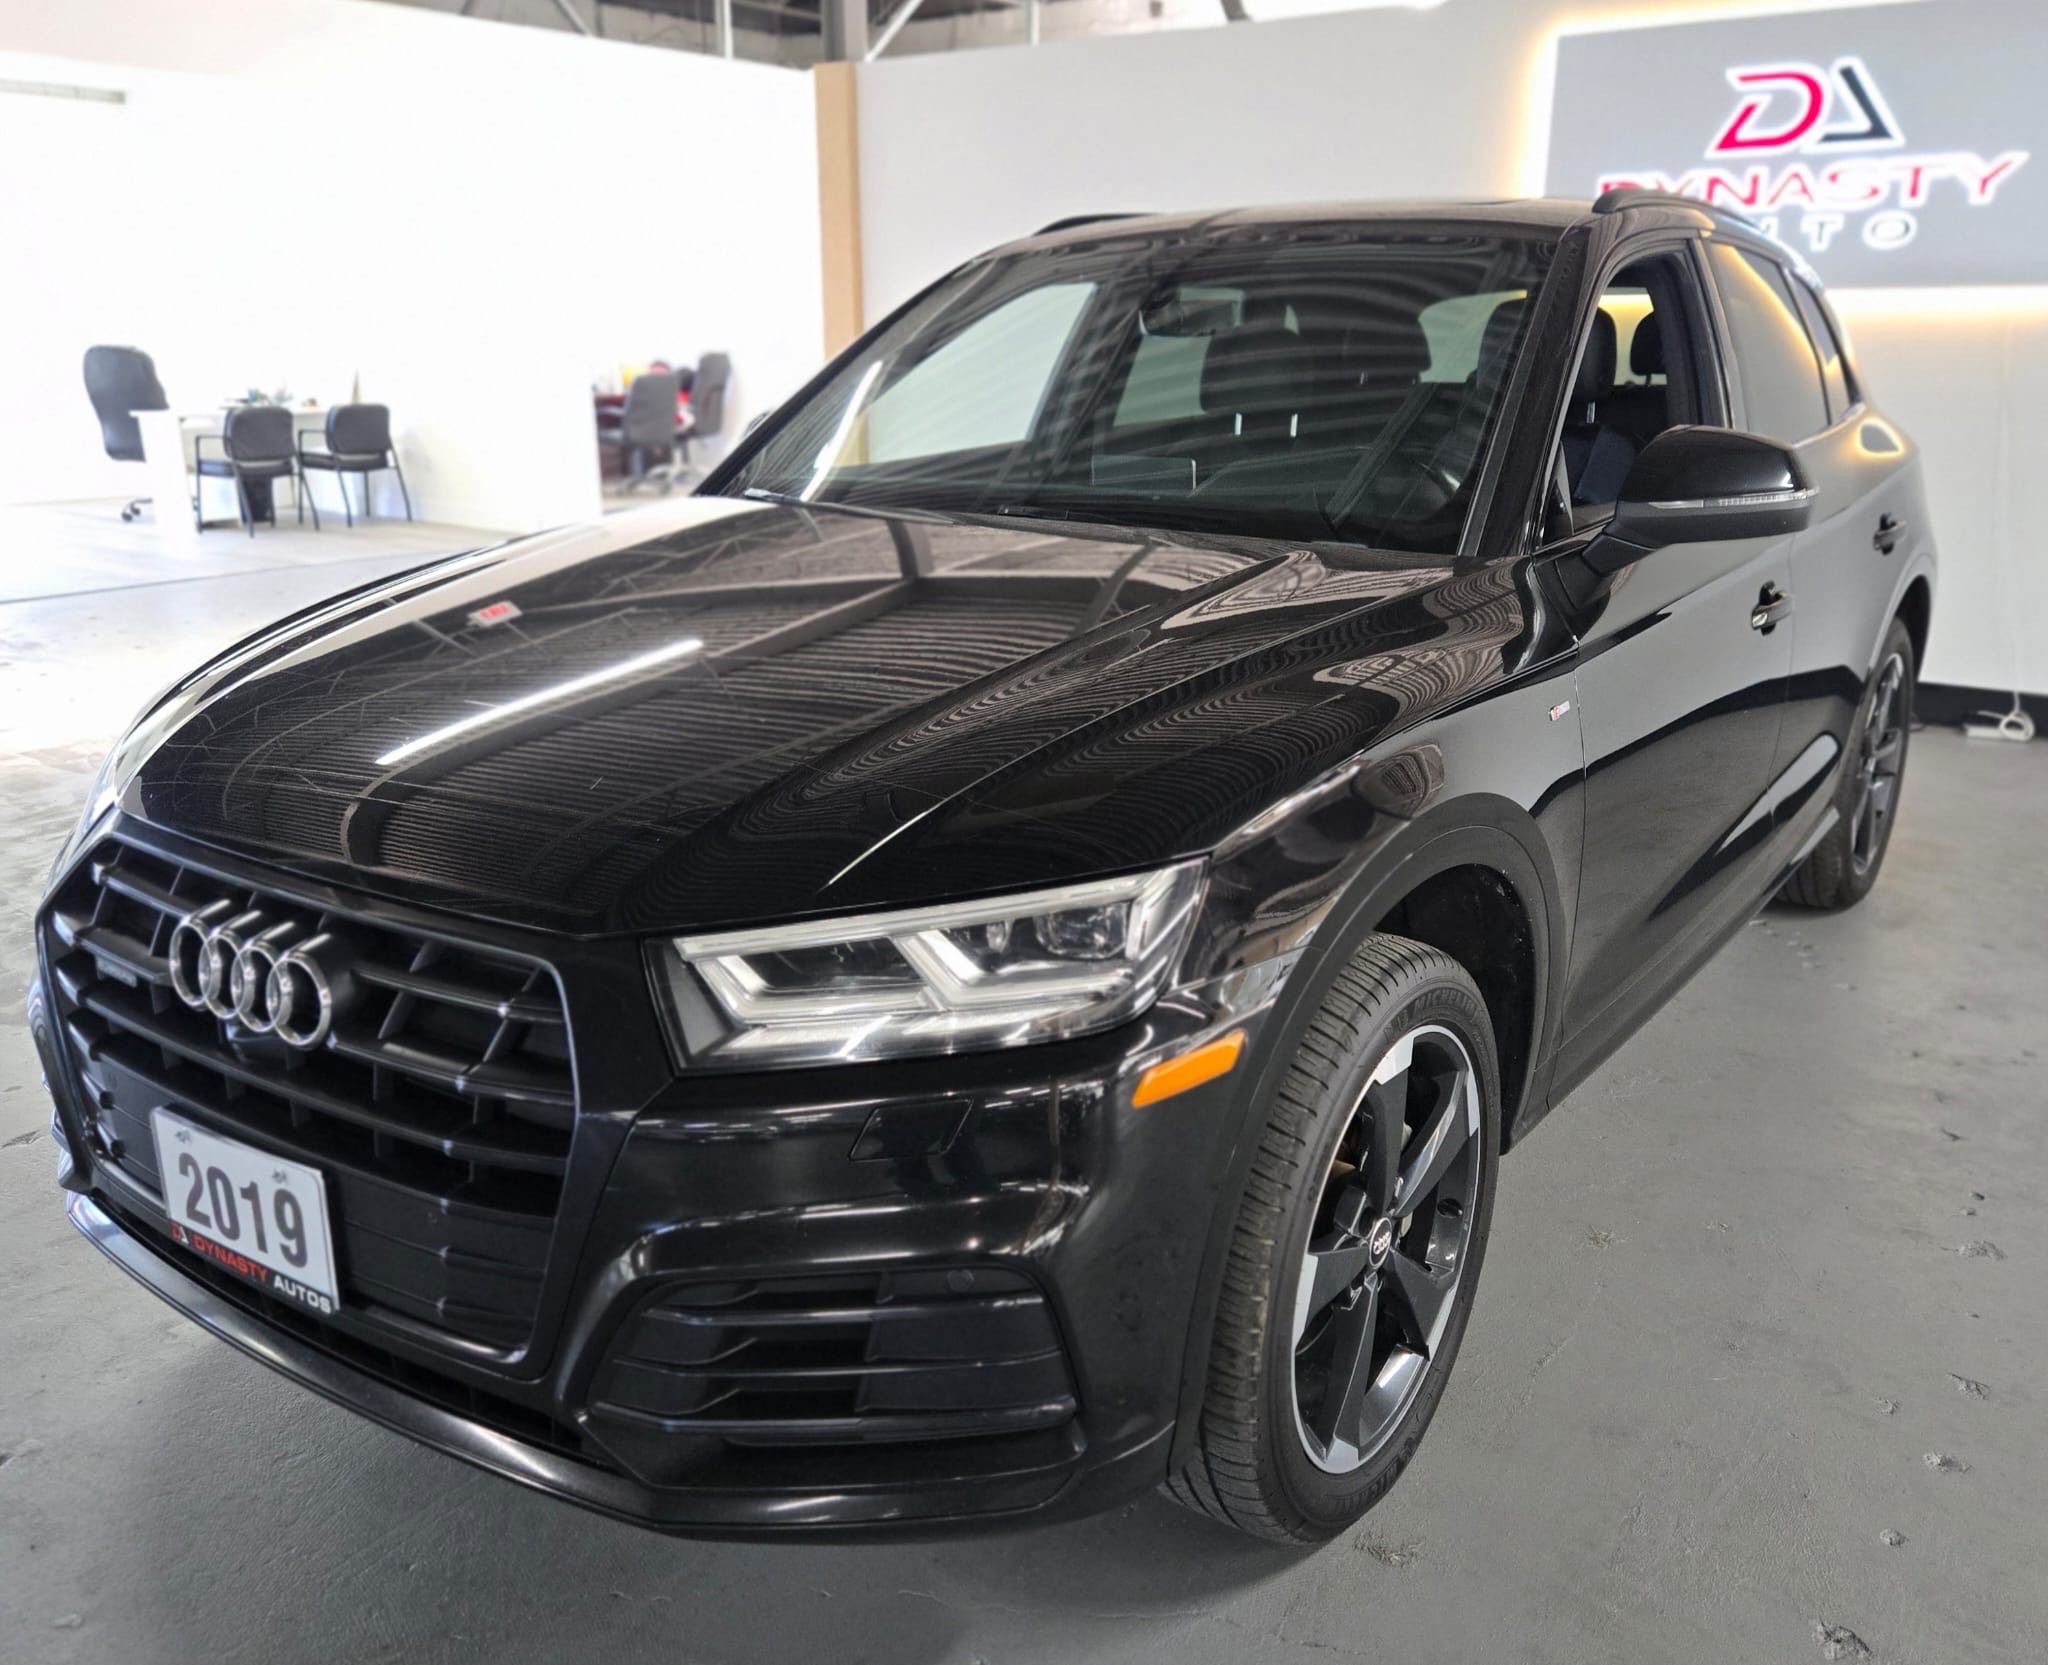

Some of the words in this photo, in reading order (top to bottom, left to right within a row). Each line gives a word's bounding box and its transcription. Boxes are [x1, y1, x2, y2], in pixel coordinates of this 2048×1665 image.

[1757, 207, 1917, 251] TO
[178, 1152, 308, 1268] 2019
[191, 1234, 269, 1281] DYNASTY
[273, 1274, 332, 1314] AUTOS
